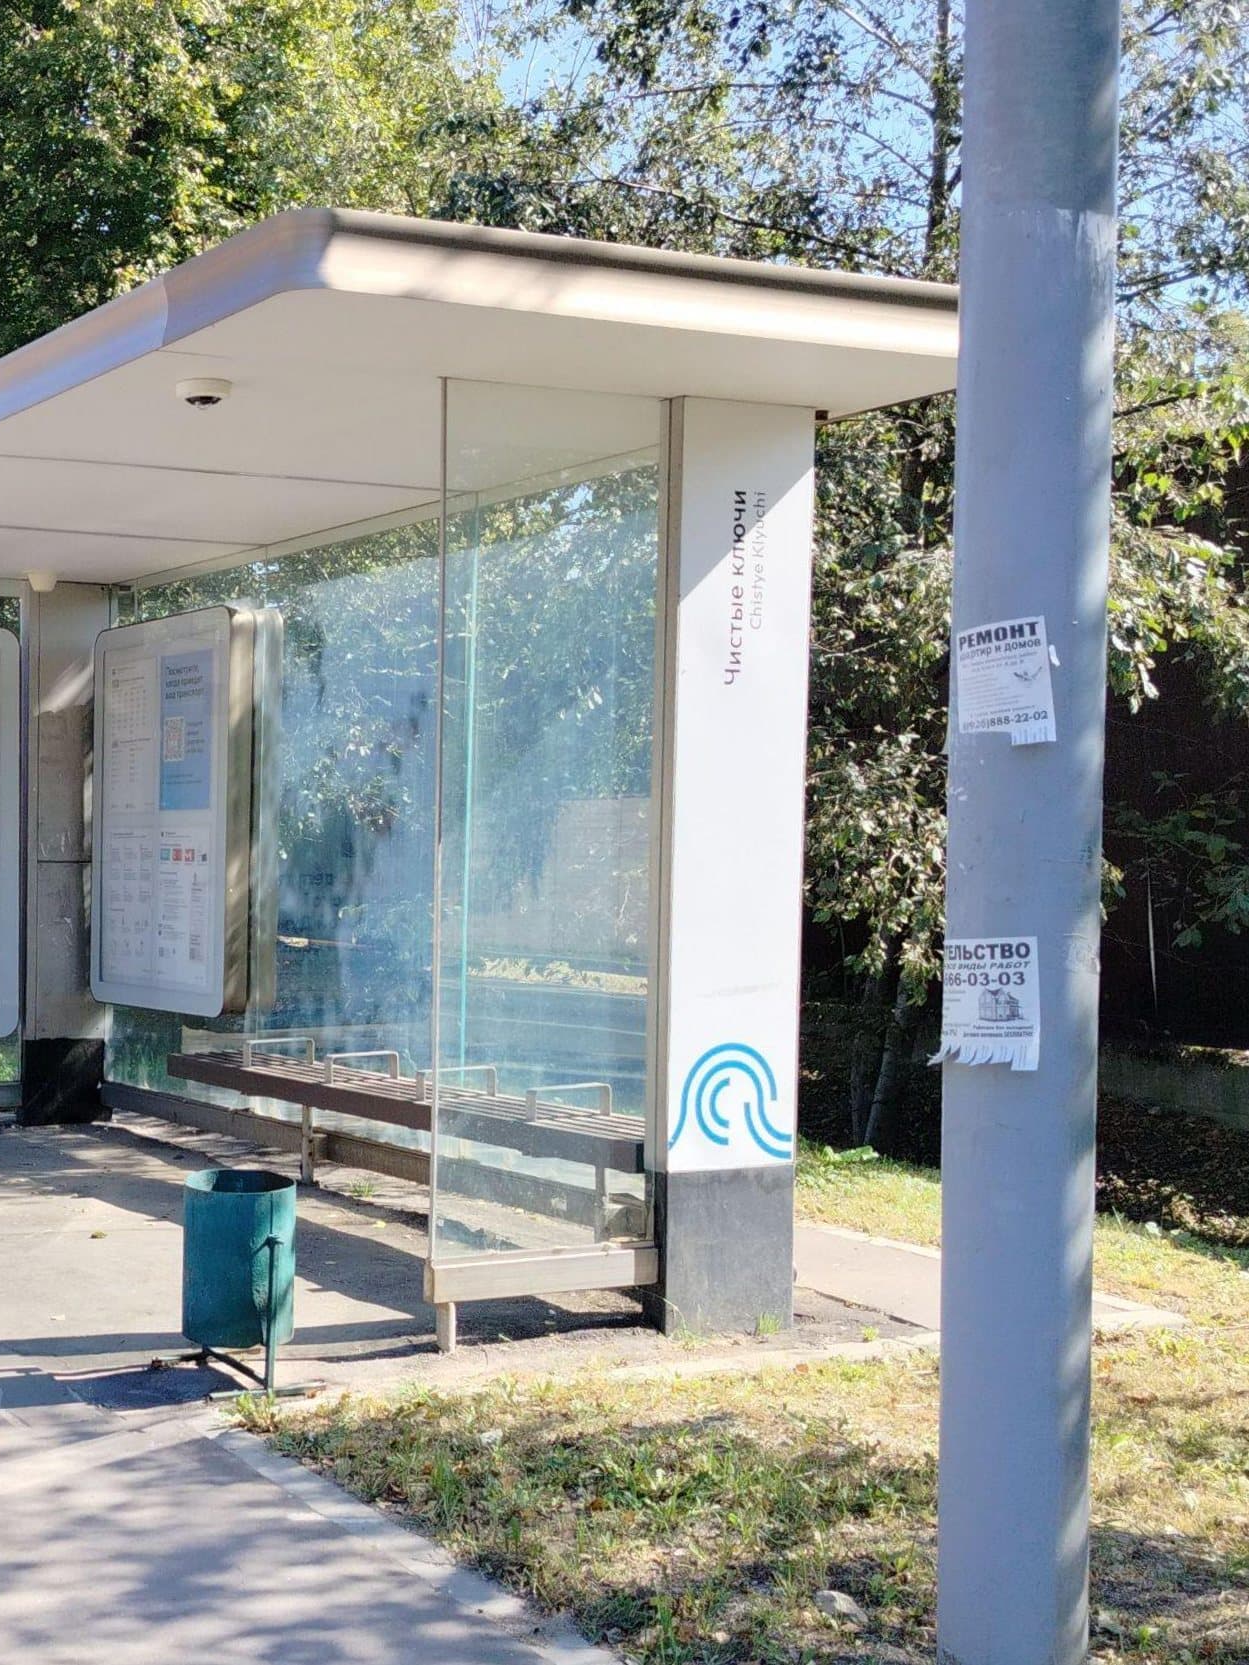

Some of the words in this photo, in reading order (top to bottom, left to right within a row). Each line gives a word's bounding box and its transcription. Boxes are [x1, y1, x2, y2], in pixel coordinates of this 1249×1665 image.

[732, 490, 748, 575] ключи
[752, 491, 768, 558] Klyuchi
[749, 563, 766, 630] Chistye
[723, 585, 744, 686] Чистые
[958, 622, 1039, 651] РЕМОНТ
[1005, 638, 1042, 653] домов
[958, 962, 987, 971] ВИДЫ
[989, 960, 1031, 970] РАБОТ
